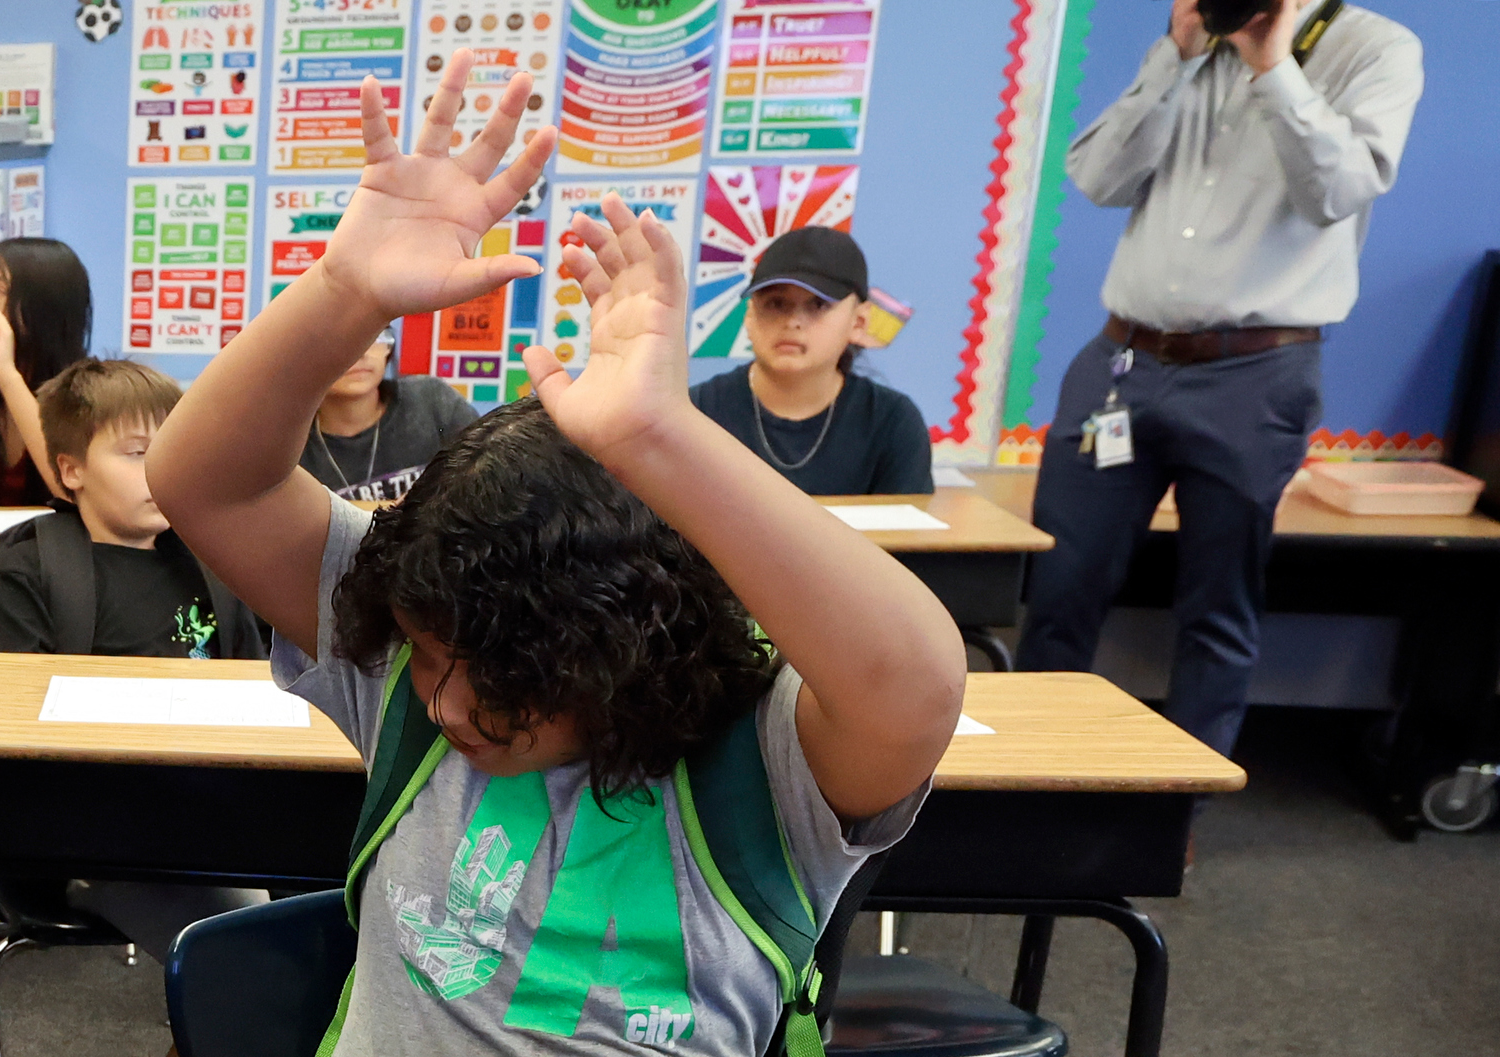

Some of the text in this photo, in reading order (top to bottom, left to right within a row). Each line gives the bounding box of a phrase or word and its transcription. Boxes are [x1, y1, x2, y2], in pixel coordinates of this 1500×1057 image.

[146, 4, 252, 21] TECHNIQUES
[176, 193, 216, 208] CAN
[275, 190, 355, 209] SELF-C
[561, 187, 602, 200] HOW
[167, 323, 214, 336] CAN'T
[454, 314, 490, 330] BIG
[626, 1005, 692, 1049] city
